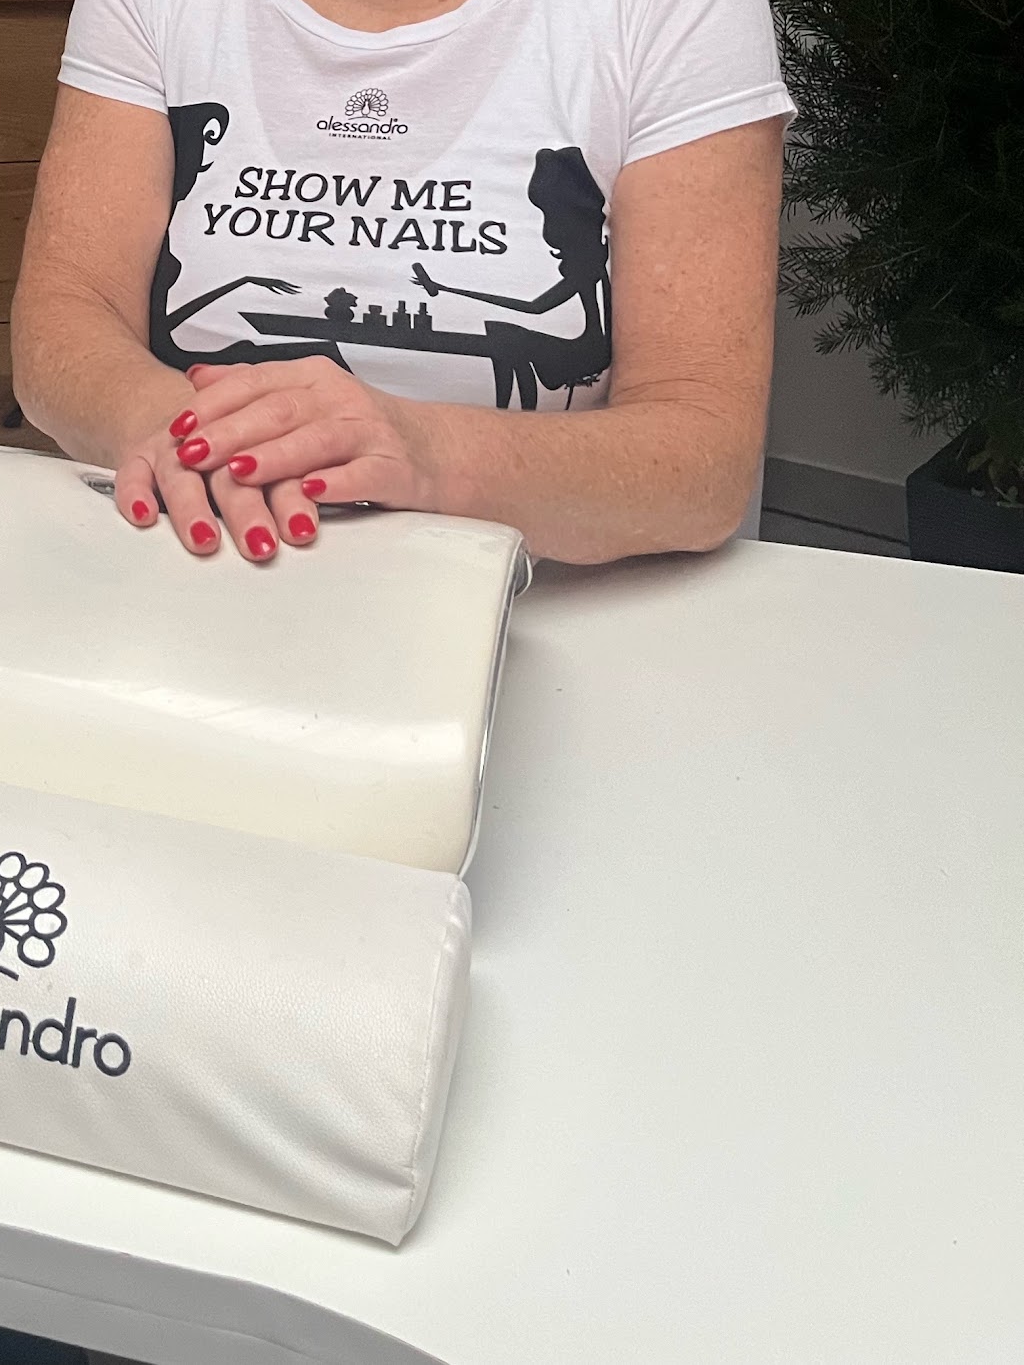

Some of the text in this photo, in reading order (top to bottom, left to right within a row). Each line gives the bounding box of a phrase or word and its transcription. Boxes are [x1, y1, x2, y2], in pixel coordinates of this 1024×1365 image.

[316, 115, 408, 135] alessandro
[328, 133, 392, 141] INTERNATIONAL
[234, 166, 472, 211] SHOW ME
[203, 203, 508, 255] YOUR NAILS
